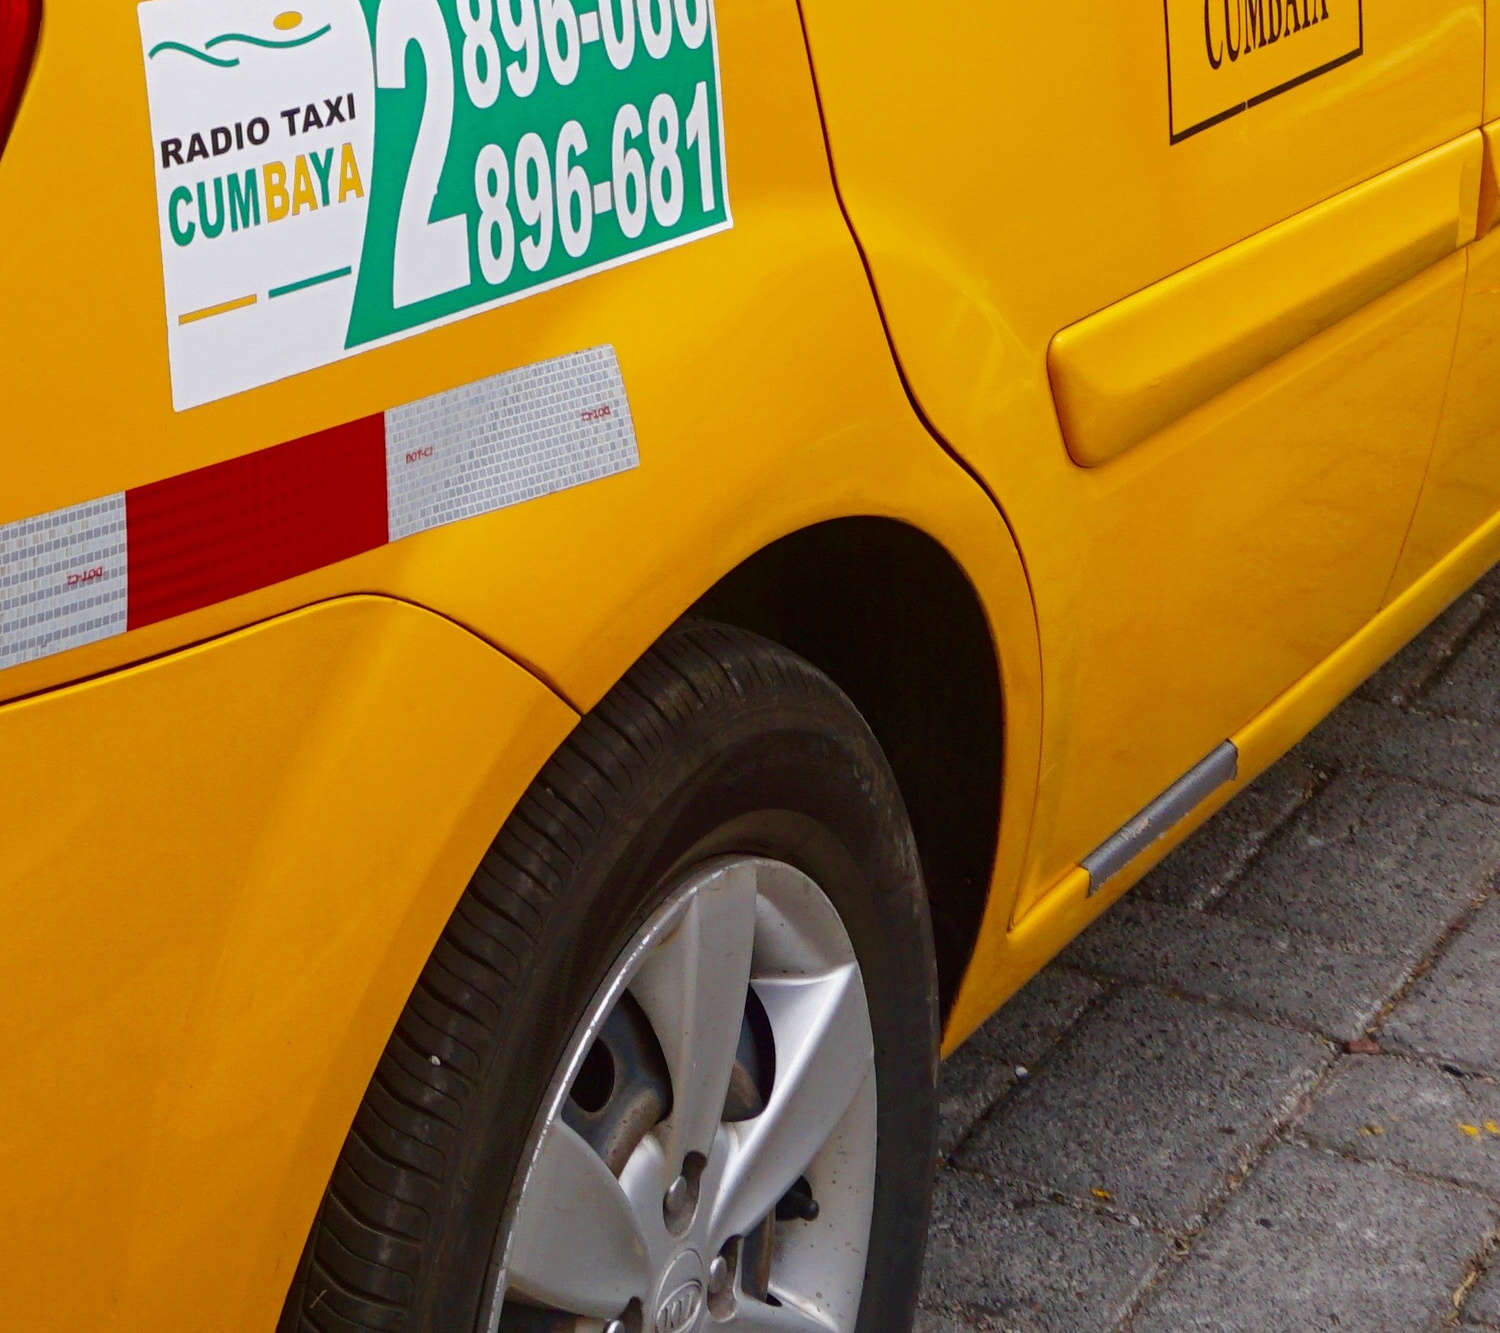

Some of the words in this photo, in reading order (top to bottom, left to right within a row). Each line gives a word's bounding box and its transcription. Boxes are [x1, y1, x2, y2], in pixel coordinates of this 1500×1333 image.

[161, 116, 270, 168] RADIO
[281, 93, 356, 135] TAXI
[475, 80, 715, 285] 896-681
[167, 143, 364, 247] CUMBAYA
